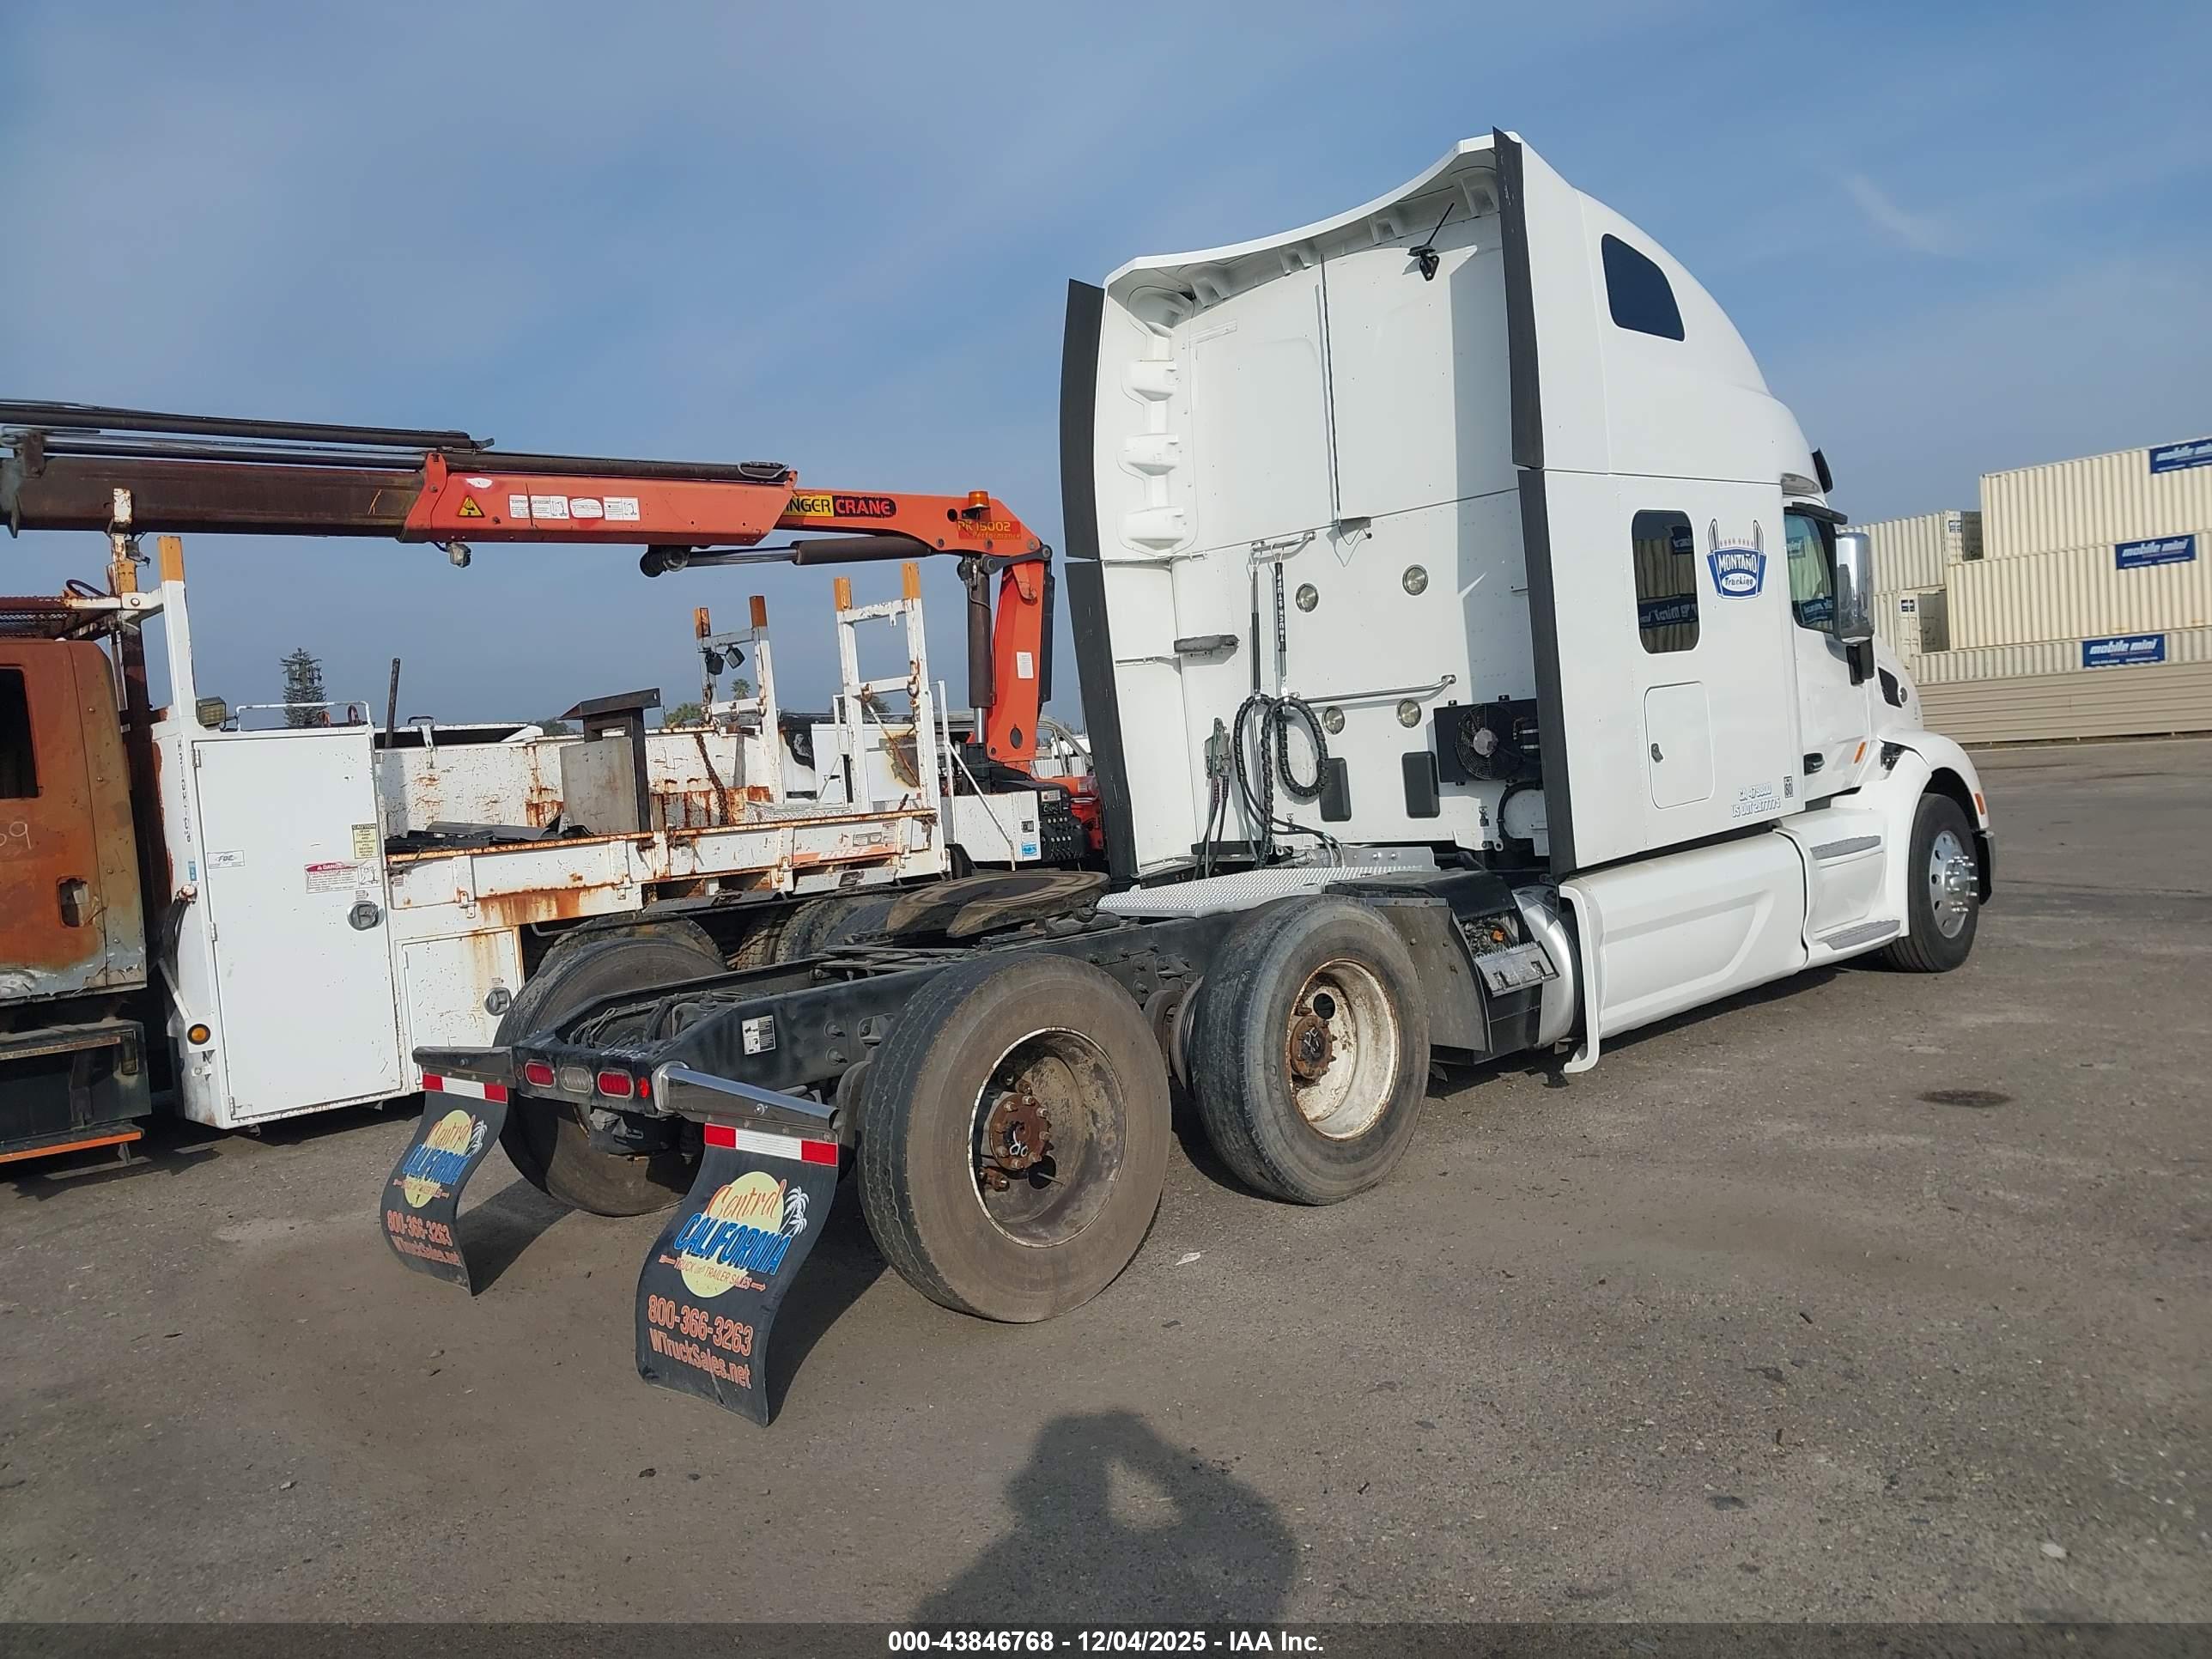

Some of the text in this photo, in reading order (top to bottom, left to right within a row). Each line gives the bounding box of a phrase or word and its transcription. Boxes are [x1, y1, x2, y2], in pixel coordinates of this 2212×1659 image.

[836, 499, 890, 515] CRANE
[1718, 554, 1758, 574] MONTAÑO
[1724, 576, 1753, 586] Trucking
[2089, 640, 2130, 655] mobile
[2130, 639, 2158, 651] mini
[402, 1144, 471, 1186] CALIFORNIA
[704, 1179, 787, 1220] Central
[673, 1212, 793, 1276] CALIFORNIA
[674, 1257, 695, 1273] TRUCK
[704, 1266, 731, 1282] TRAILER
[730, 1274, 752, 1290] SALES
[647, 1294, 754, 1357] 800-366-3263
[649, 1328, 751, 1389] WTruckSales.net
